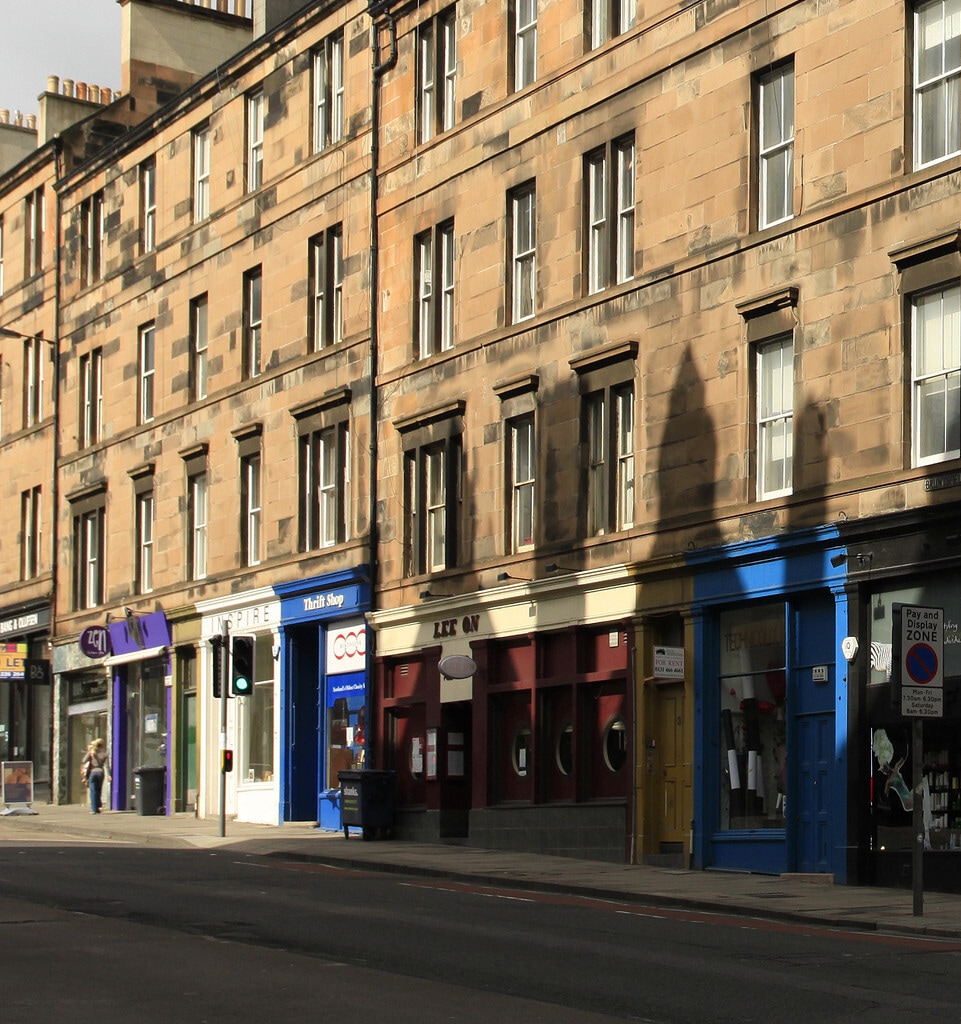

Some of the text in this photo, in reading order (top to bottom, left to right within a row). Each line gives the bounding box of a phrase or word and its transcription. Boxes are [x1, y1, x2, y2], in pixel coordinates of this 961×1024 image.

[304, 594, 344, 611] Thrift Shop
[211, 606, 269, 632] INSPIRE
[906, 609, 939, 620] Pay and
[0, 620, 13, 633] BANG
[433, 614, 480, 639] LEE ON
[907, 619, 938, 631] Display
[906, 630, 938, 642] ZONE
